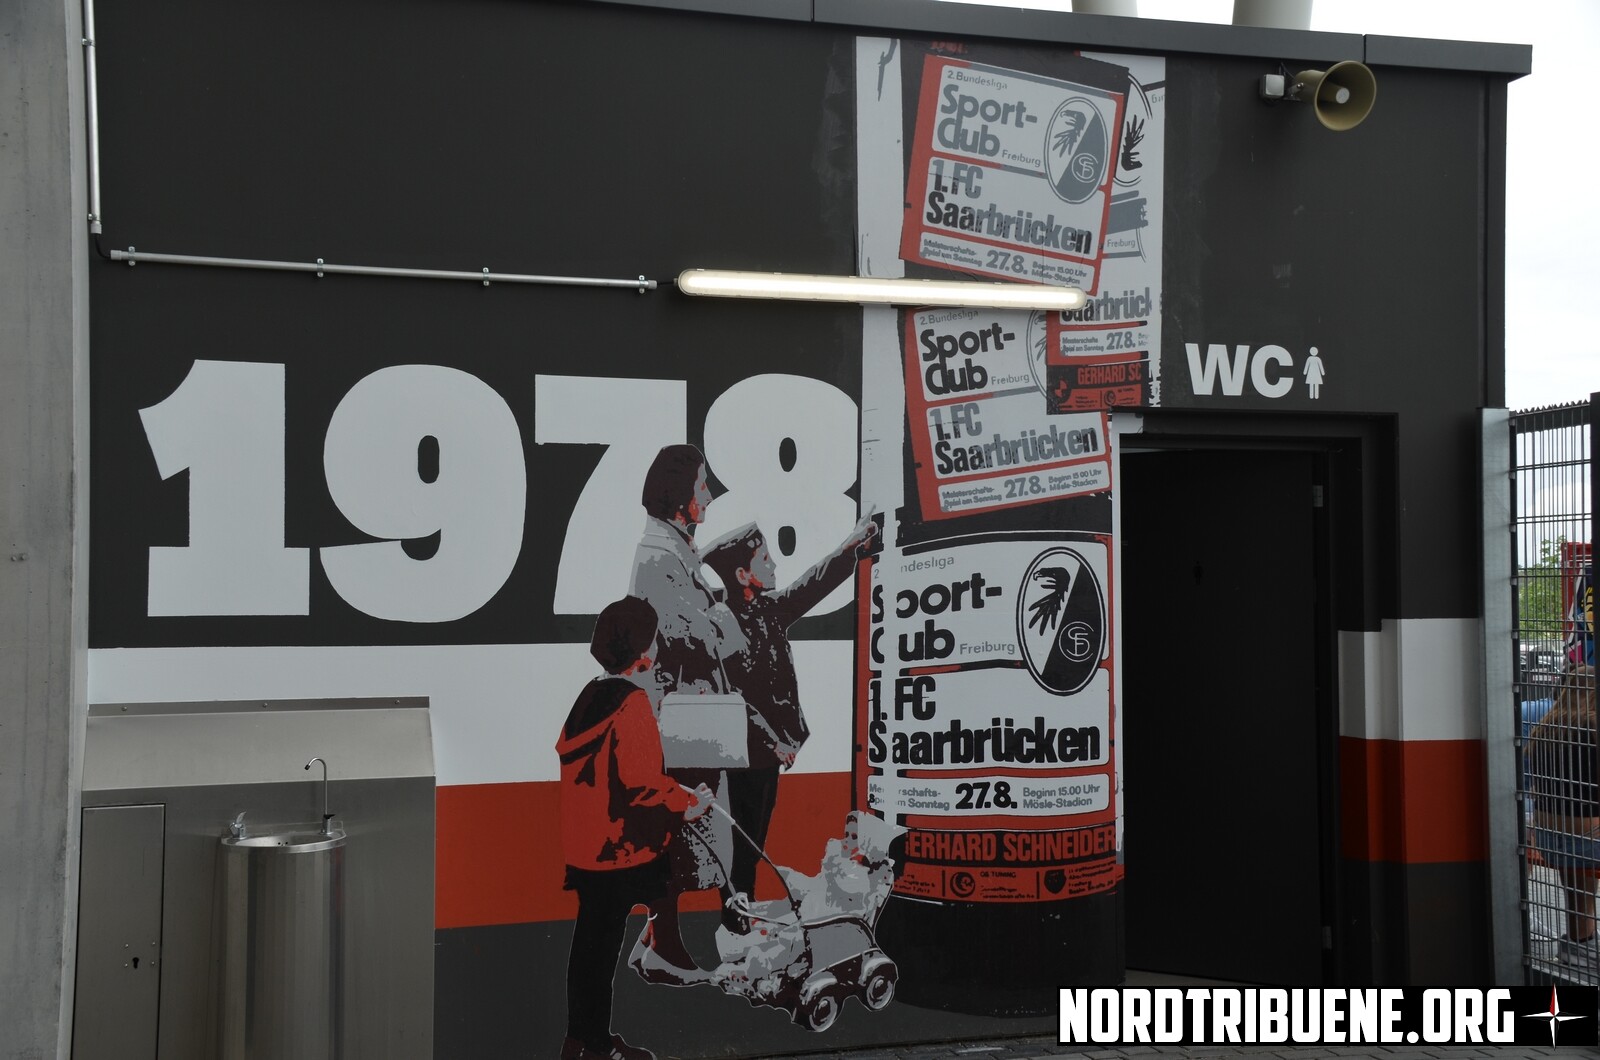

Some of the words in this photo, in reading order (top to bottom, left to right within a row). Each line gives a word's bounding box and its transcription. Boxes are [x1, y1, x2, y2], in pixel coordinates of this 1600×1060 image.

[940, 84, 1038, 128] Sport-
[1002, 149, 1042, 168] Freiburg
[932, 159, 949, 195] 1.
[949, 166, 984, 199] FC
[926, 191, 1092, 255] Saarbrücken
[1107, 238, 1136, 251] Freiburg
[986, 250, 1028, 275] 27.8.
[920, 322, 1015, 362] Sport-
[1106, 331, 1135, 350] 27.8.
[991, 373, 1030, 387] Freiburg
[1078, 364, 1125, 385] GERHARD
[1185, 343, 1294, 398] WC
[930, 405, 952, 441] 1.
[952, 402, 982, 438] FC
[934, 424, 1099, 475] Saarbrücken
[138, 359, 859, 623] 1978
[1004, 476, 1046, 499] 27.8.
[959, 641, 1015, 656] Freiburg
[870, 680, 887, 721] 1.
[895, 675, 936, 721] FC
[869, 716, 1100, 765] Saarbrücken
[907, 798, 950, 811] Sonntag
[955, 781, 1018, 809] 27.8.
[1023, 786, 1056, 798] Beginn
[1058, 785, 1082, 796] 15.00
[1083, 783, 1101, 795] Uhr
[905, 831, 997, 861] ERHARD
[1003, 825, 1117, 862] SCHNEIDER
